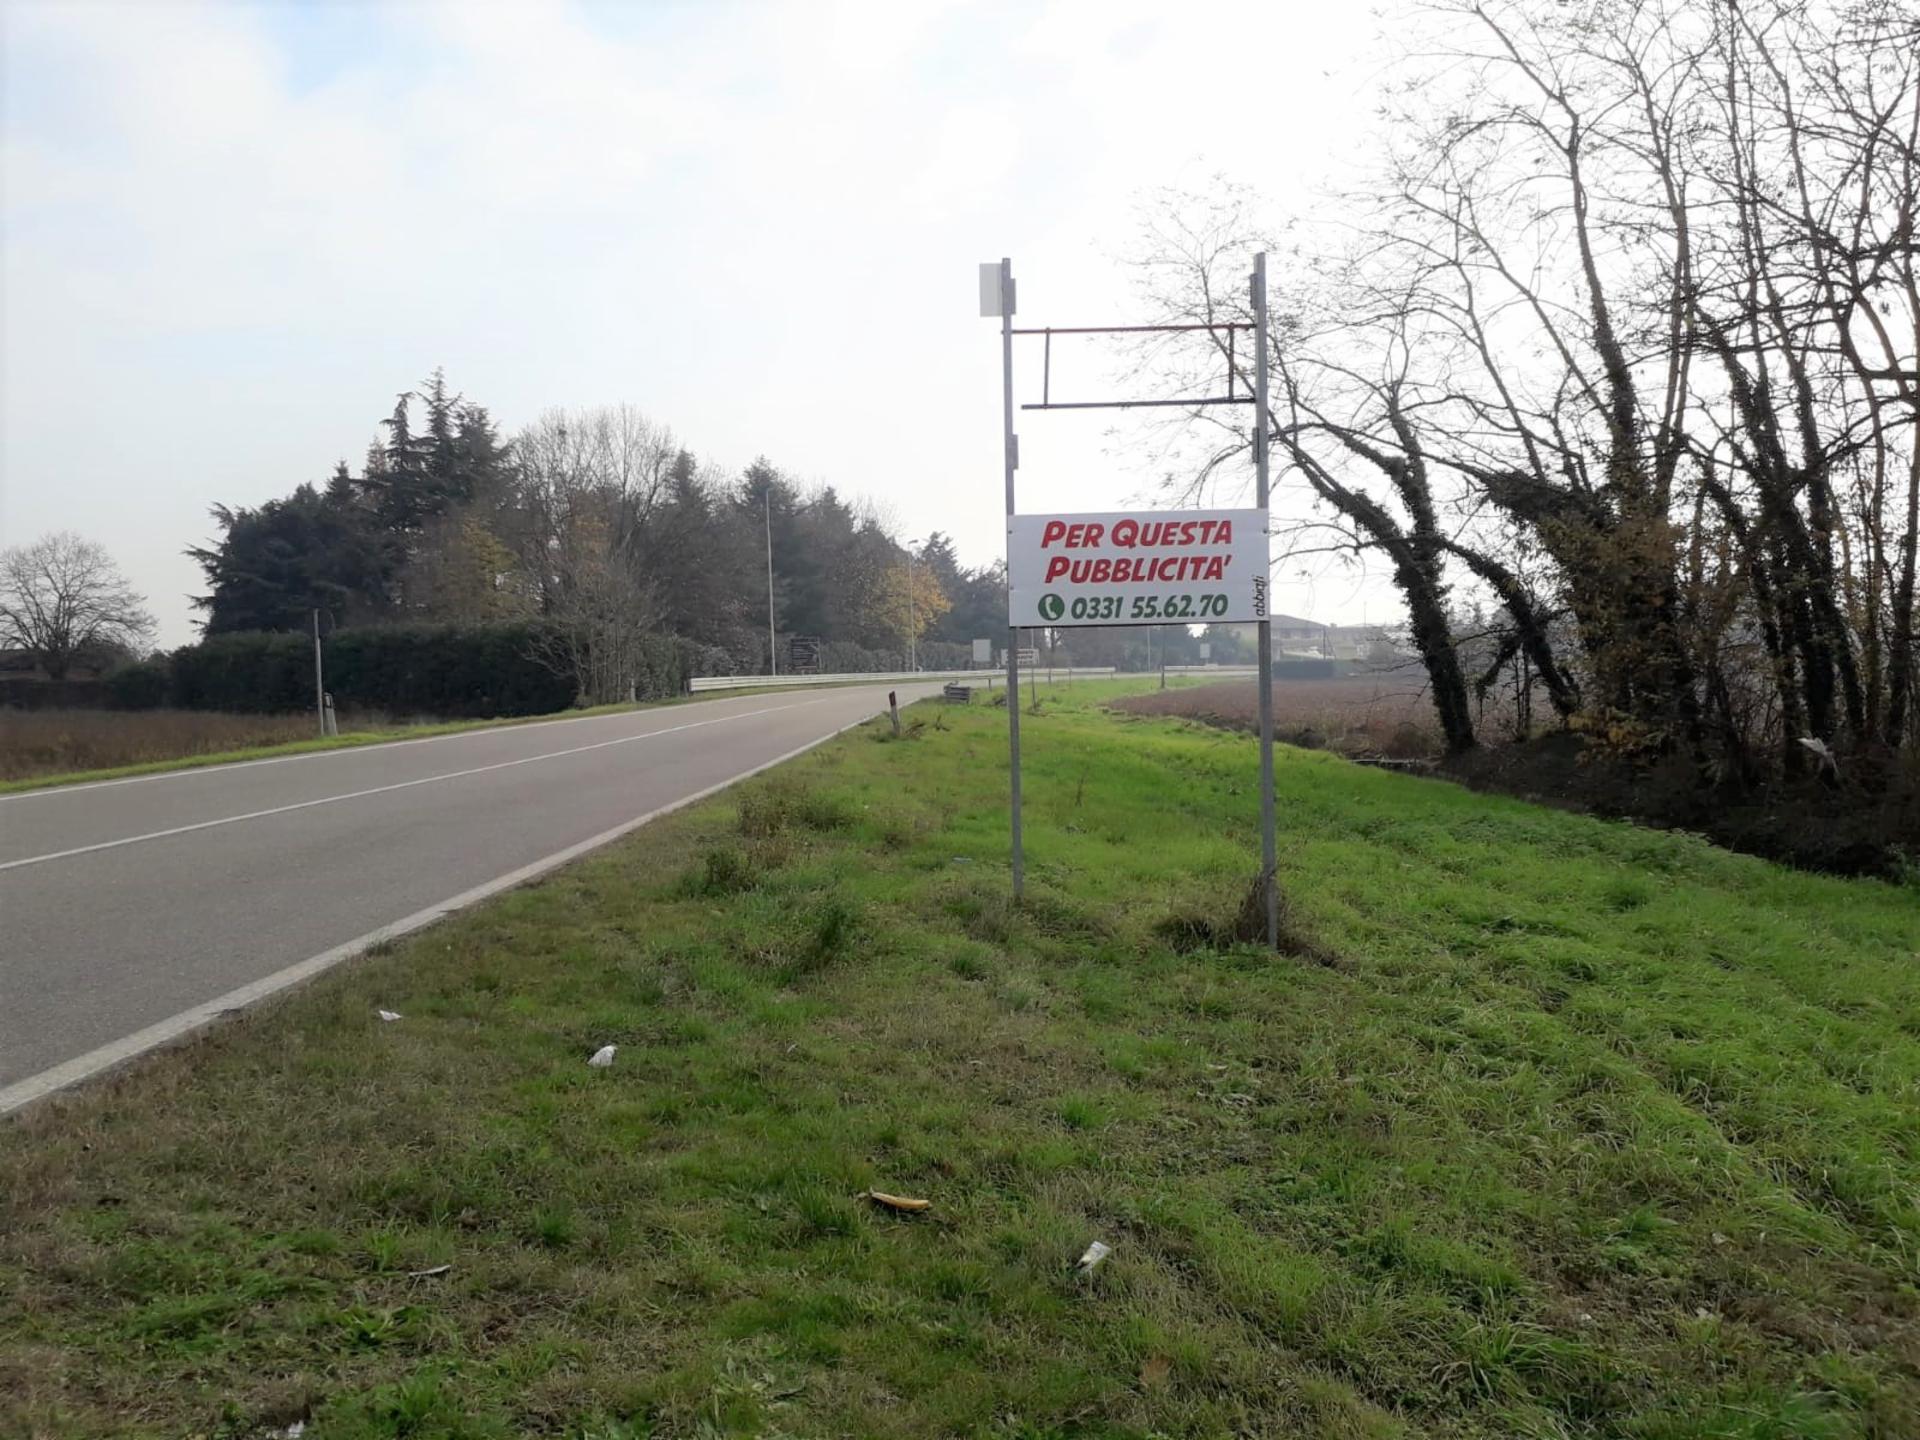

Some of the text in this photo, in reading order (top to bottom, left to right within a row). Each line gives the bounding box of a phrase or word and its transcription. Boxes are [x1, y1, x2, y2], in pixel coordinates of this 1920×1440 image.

[1041, 519, 1232, 549] PER QUESTA
[1044, 555, 1231, 583] PUBBLICITA'
[1071, 594, 1229, 619] 0331 55.62.70
